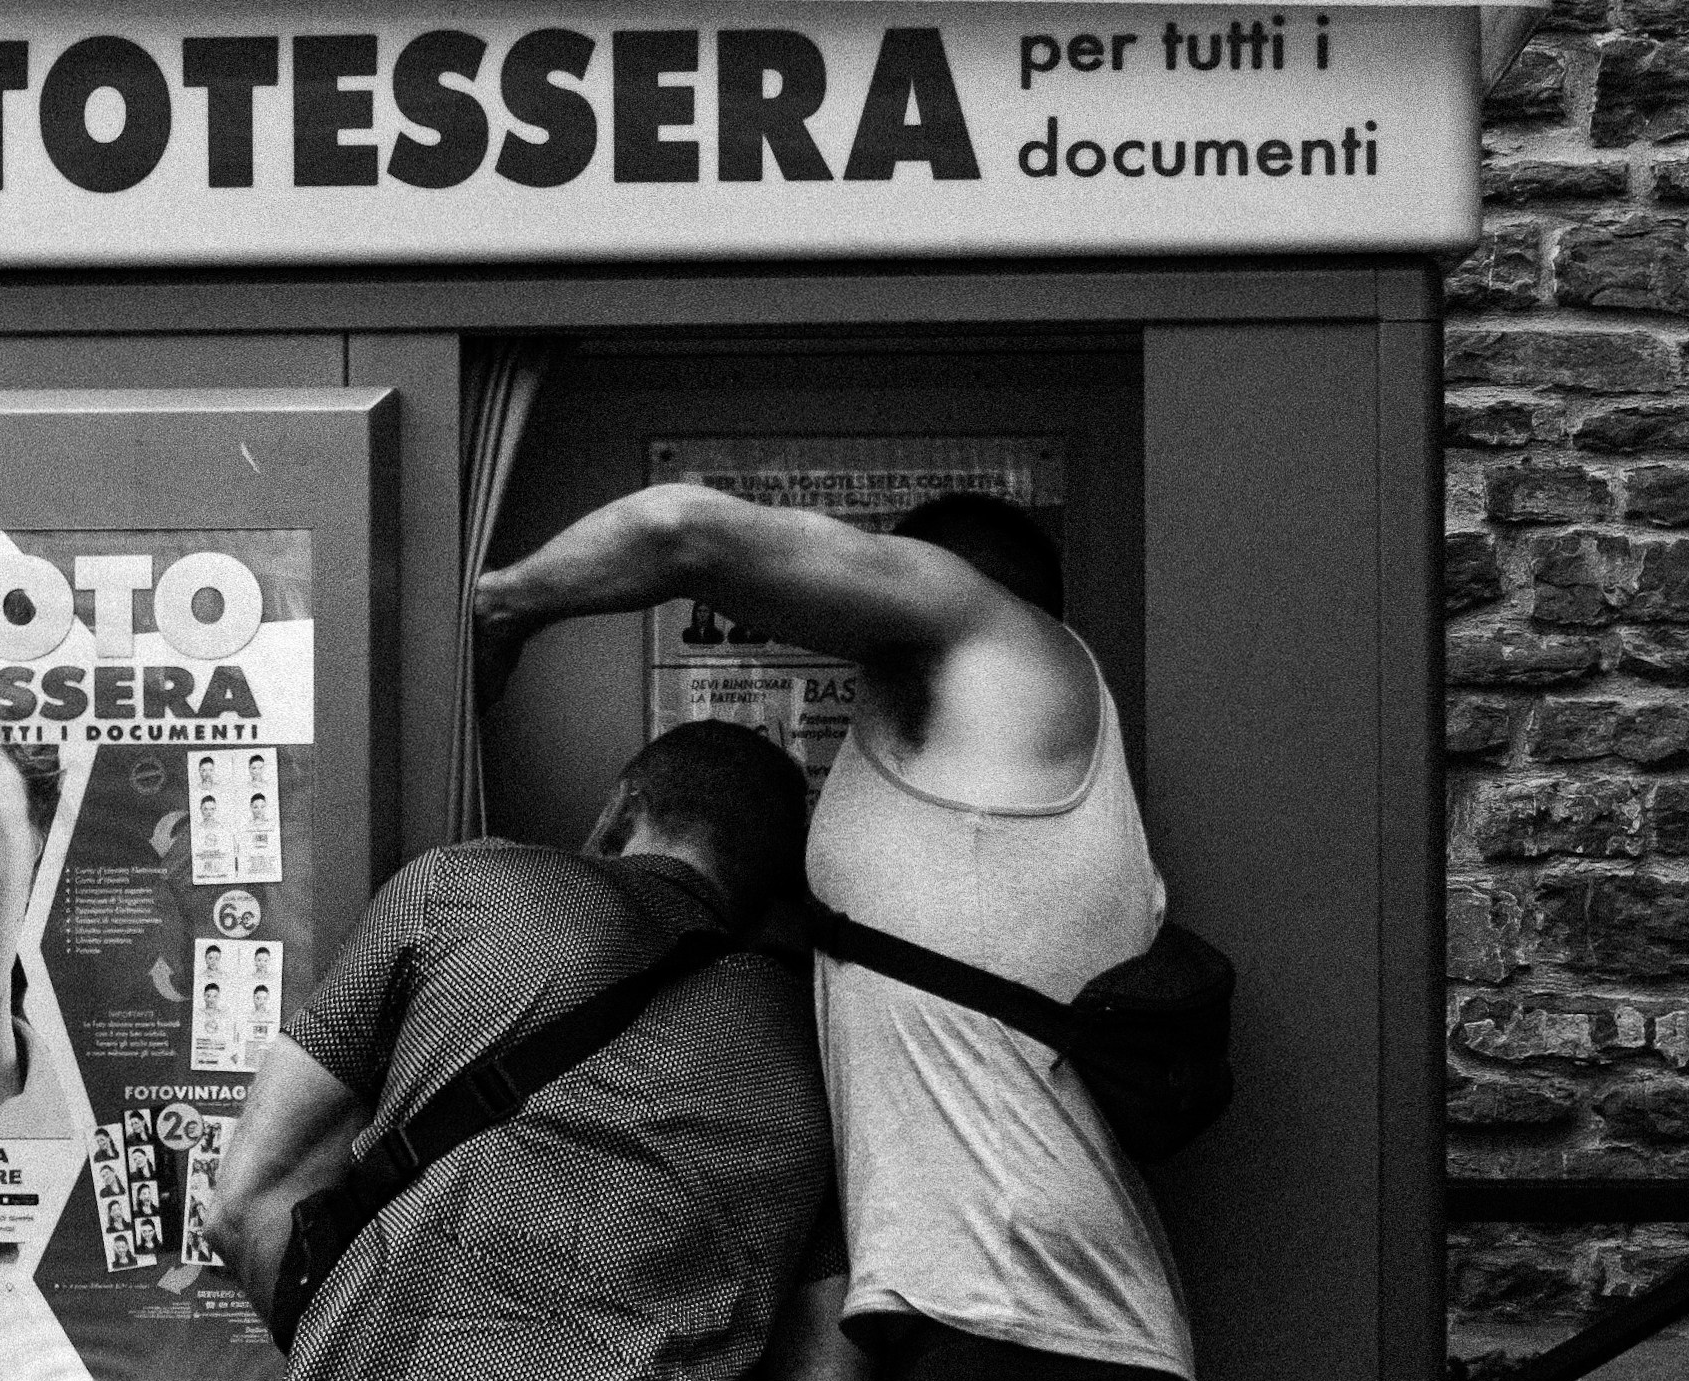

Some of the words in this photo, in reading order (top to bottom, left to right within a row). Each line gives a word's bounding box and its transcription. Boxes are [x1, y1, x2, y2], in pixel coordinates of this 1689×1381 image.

[1020, 33, 1137, 90] per
[1162, 14, 1285, 70] tutti
[1316, 14, 1329, 70] i
[1018, 116, 1377, 177] documenti
[803, 677, 858, 704] BAS
[61, 725, 67, 741] I
[86, 724, 258, 742] DOCUMENTI
[163, 1111, 200, 1141] 2€
